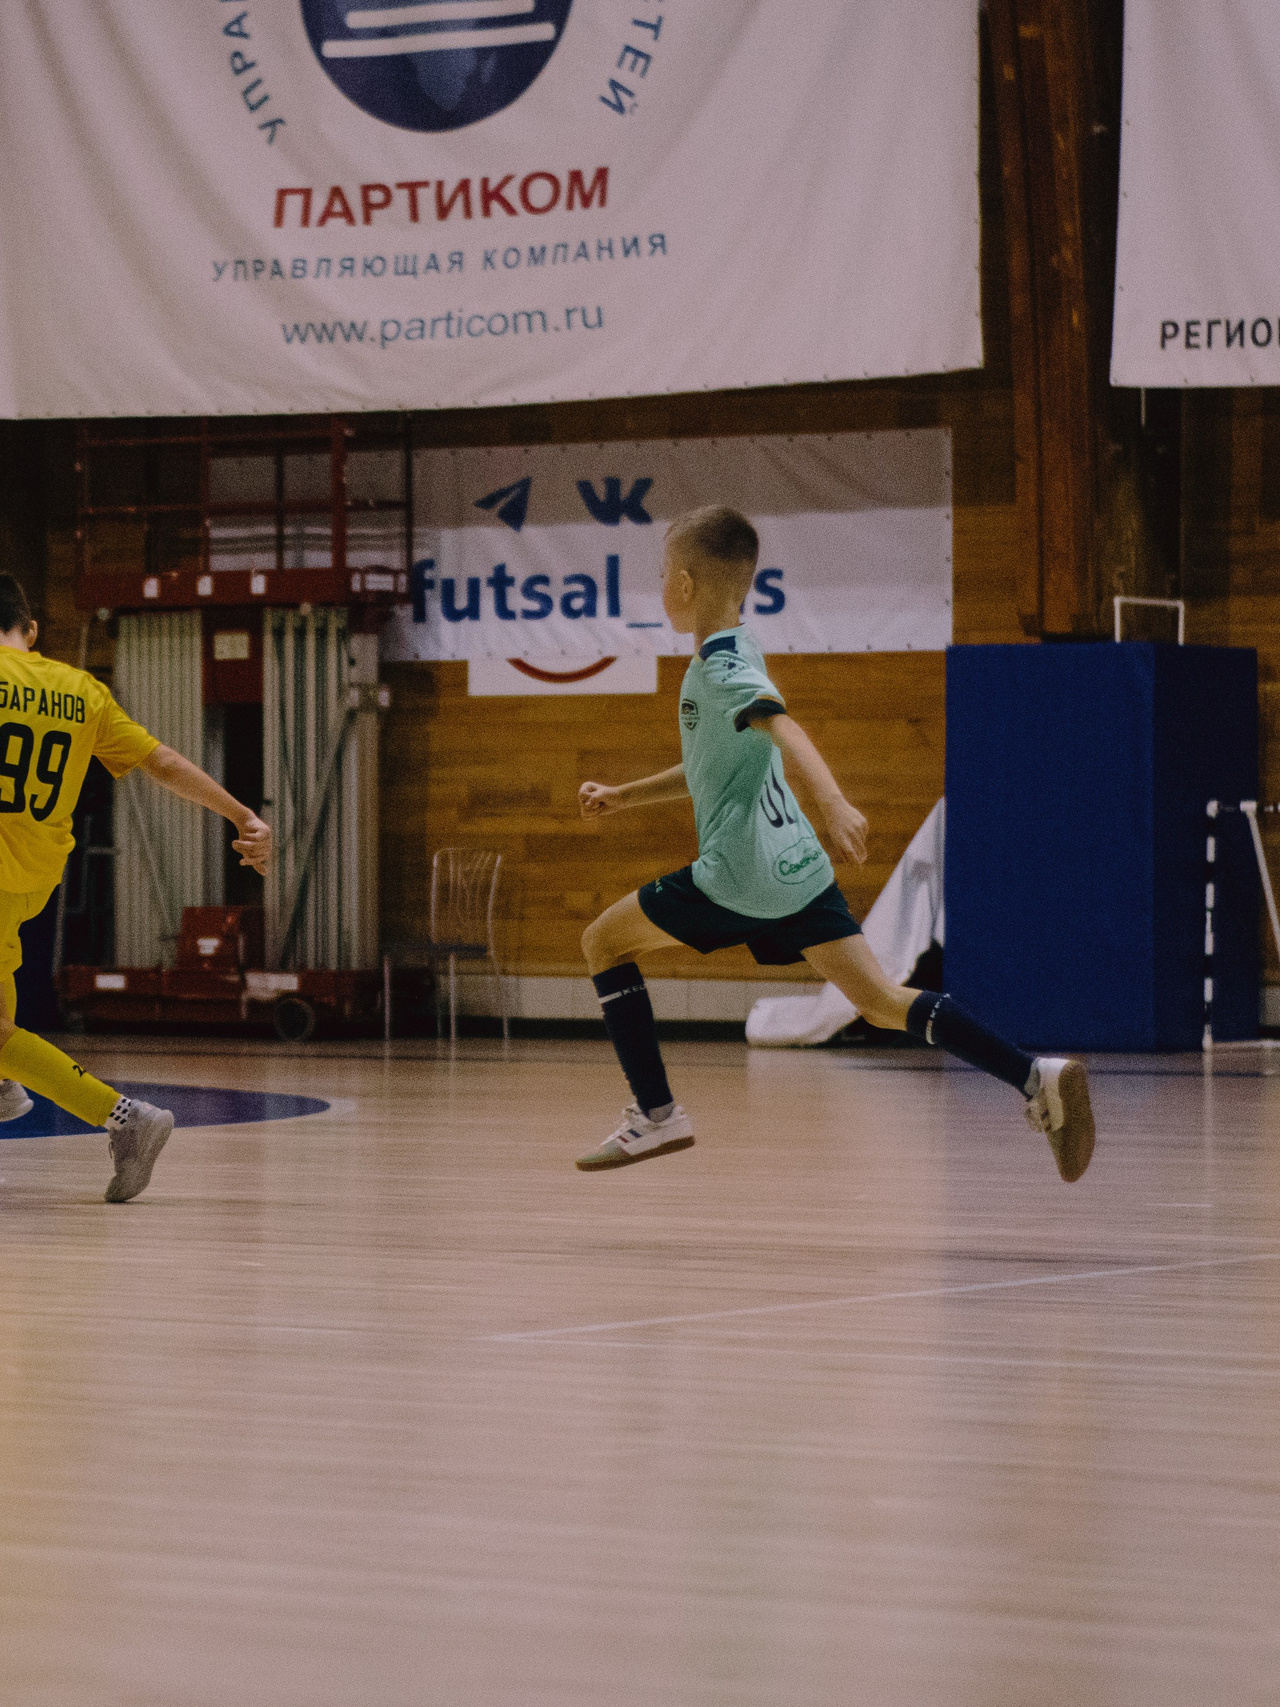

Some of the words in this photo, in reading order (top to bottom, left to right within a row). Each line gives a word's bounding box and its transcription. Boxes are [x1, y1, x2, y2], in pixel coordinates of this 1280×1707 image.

[222, 0, 286, 146] УПРА
[599, 0, 664, 115] ТЕЙ
[273, 167, 610, 228] ПАРТИКОМ
[211, 250, 466, 283] УПРАВЛЯЮЩАЯ
[482, 233, 669, 271] КОМПАНИЯ
[281, 305, 605, 348] www.particom.ru
[1160, 317, 1280, 350] РЕГИО
[412, 554, 786, 629] futsal_s
